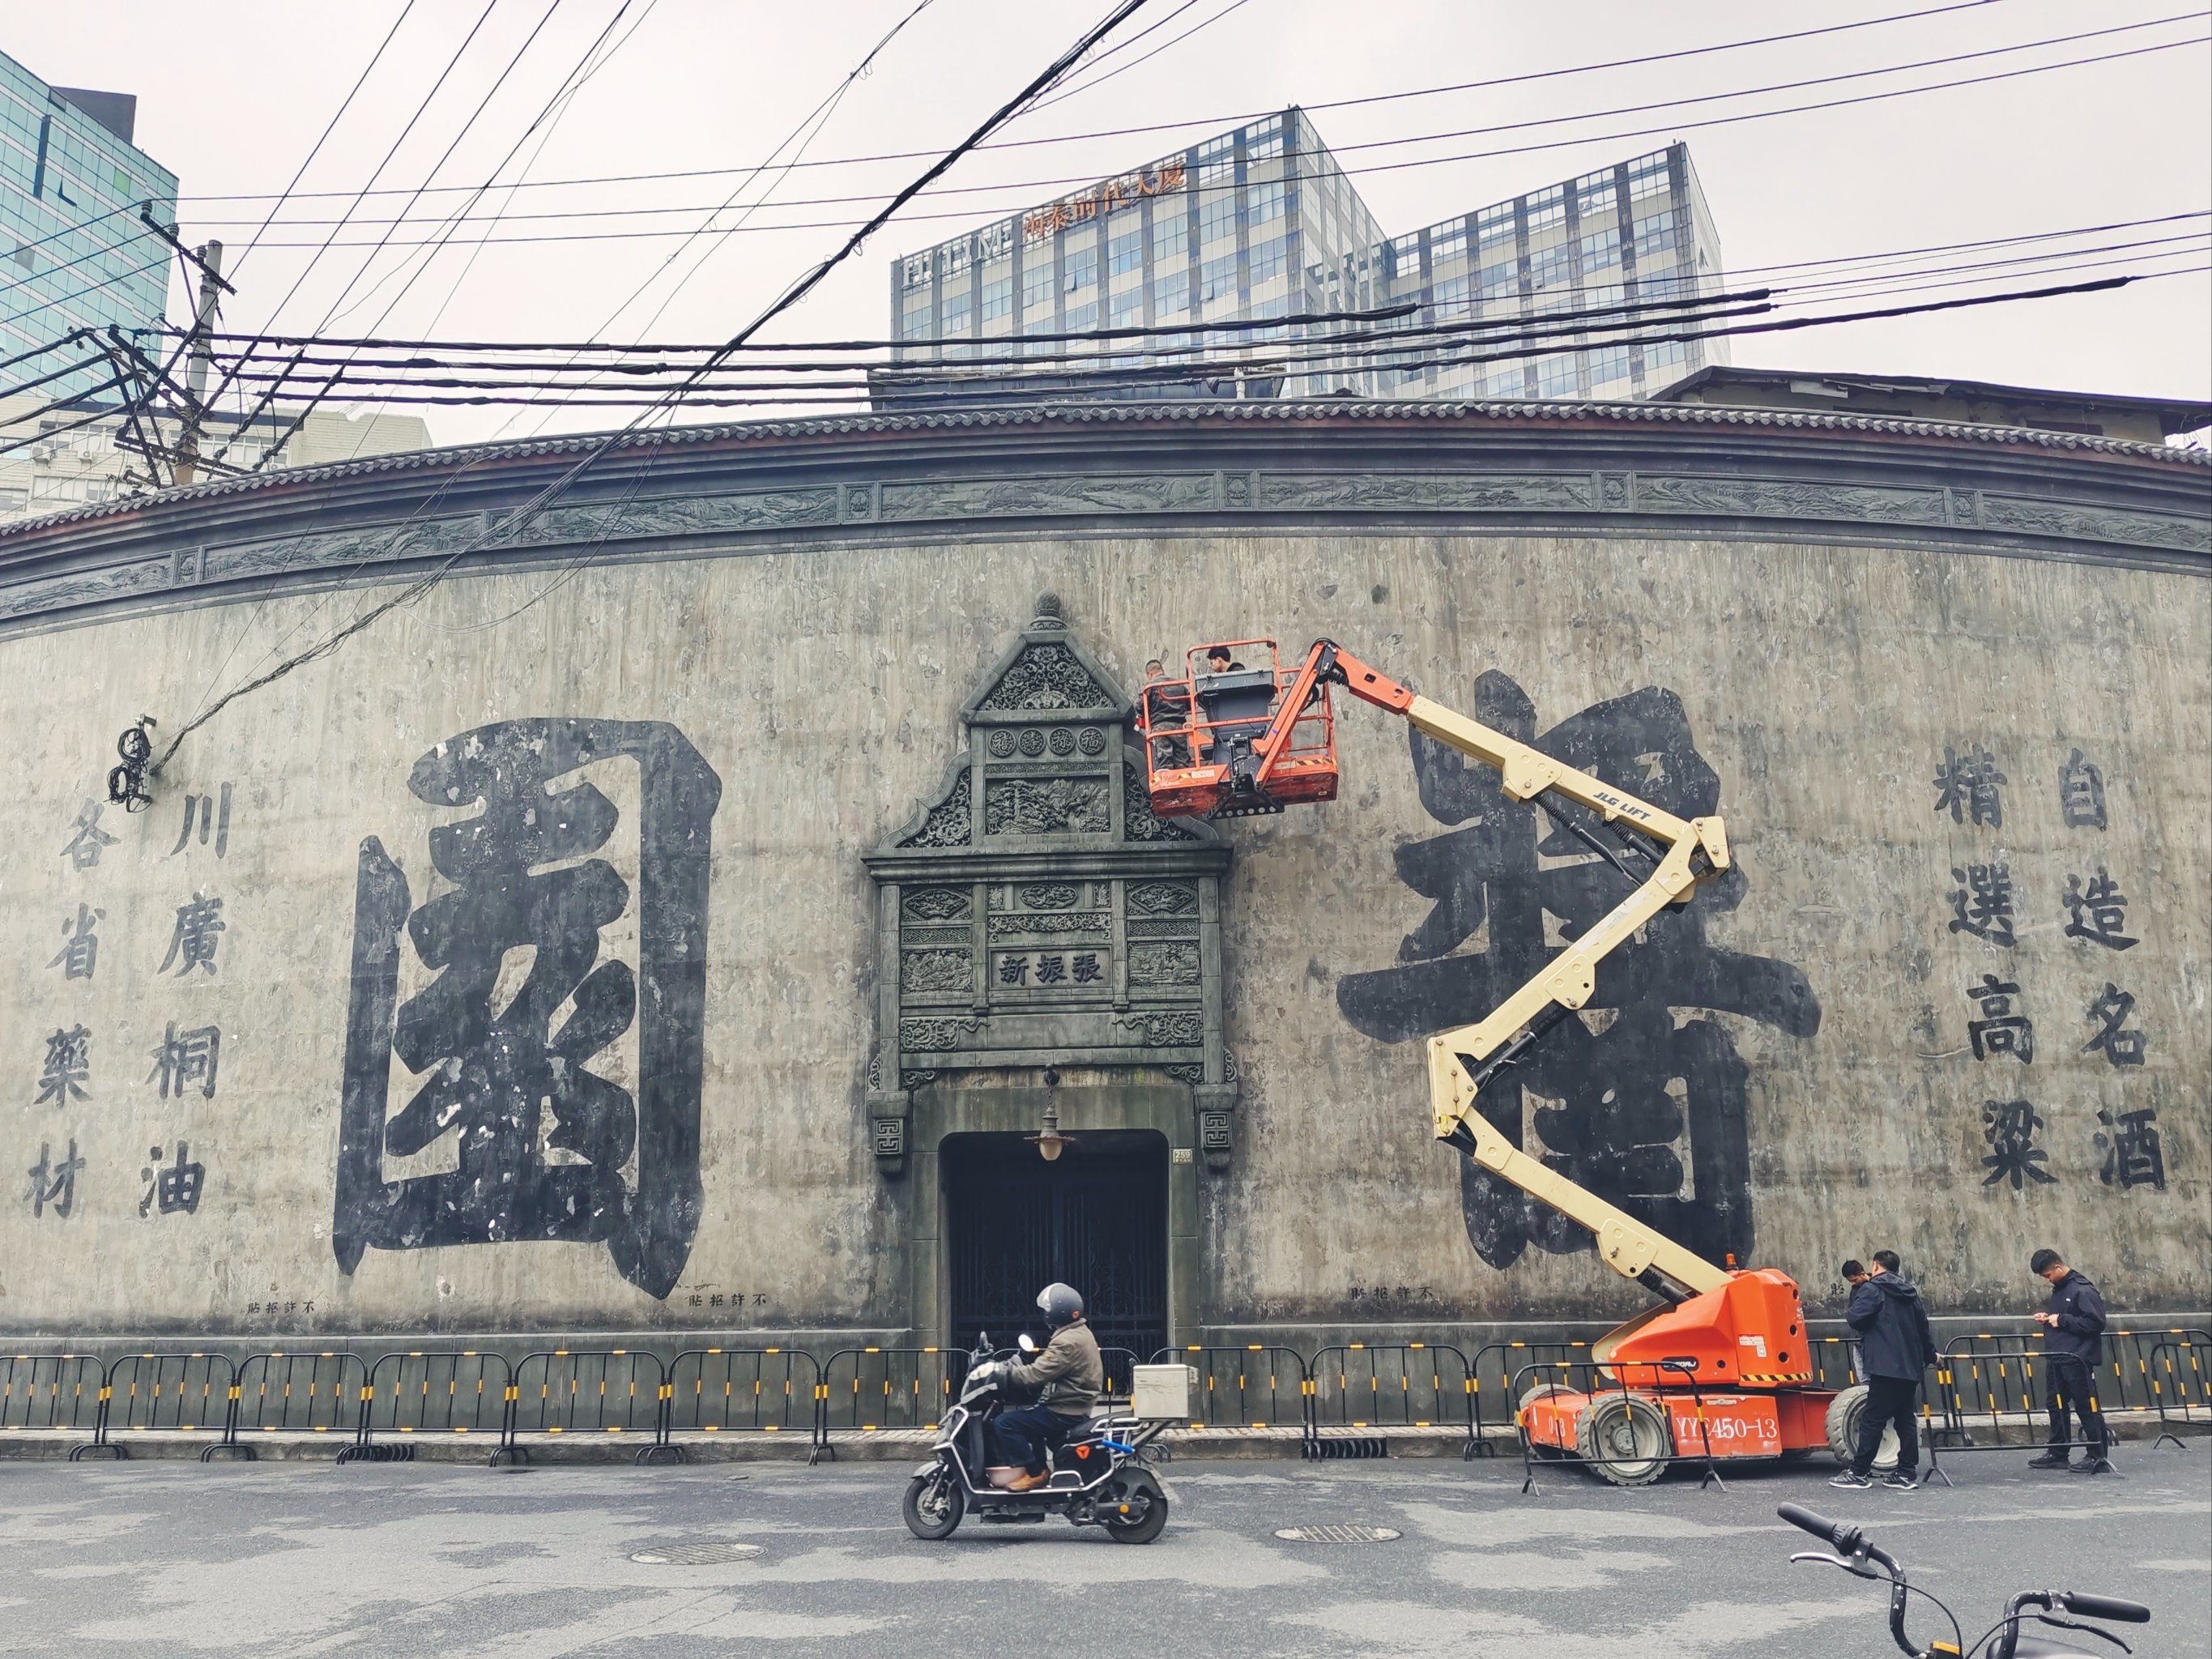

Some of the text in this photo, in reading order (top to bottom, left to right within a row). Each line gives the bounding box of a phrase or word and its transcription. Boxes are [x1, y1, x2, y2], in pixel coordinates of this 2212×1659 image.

[23, 797, 121, 1219] 各省藥材
[139, 782, 232, 1218] 川廣桐油
[1593, 791, 1652, 821] JLG LIFT
[2058, 748, 2165, 1191] 自造名酒
